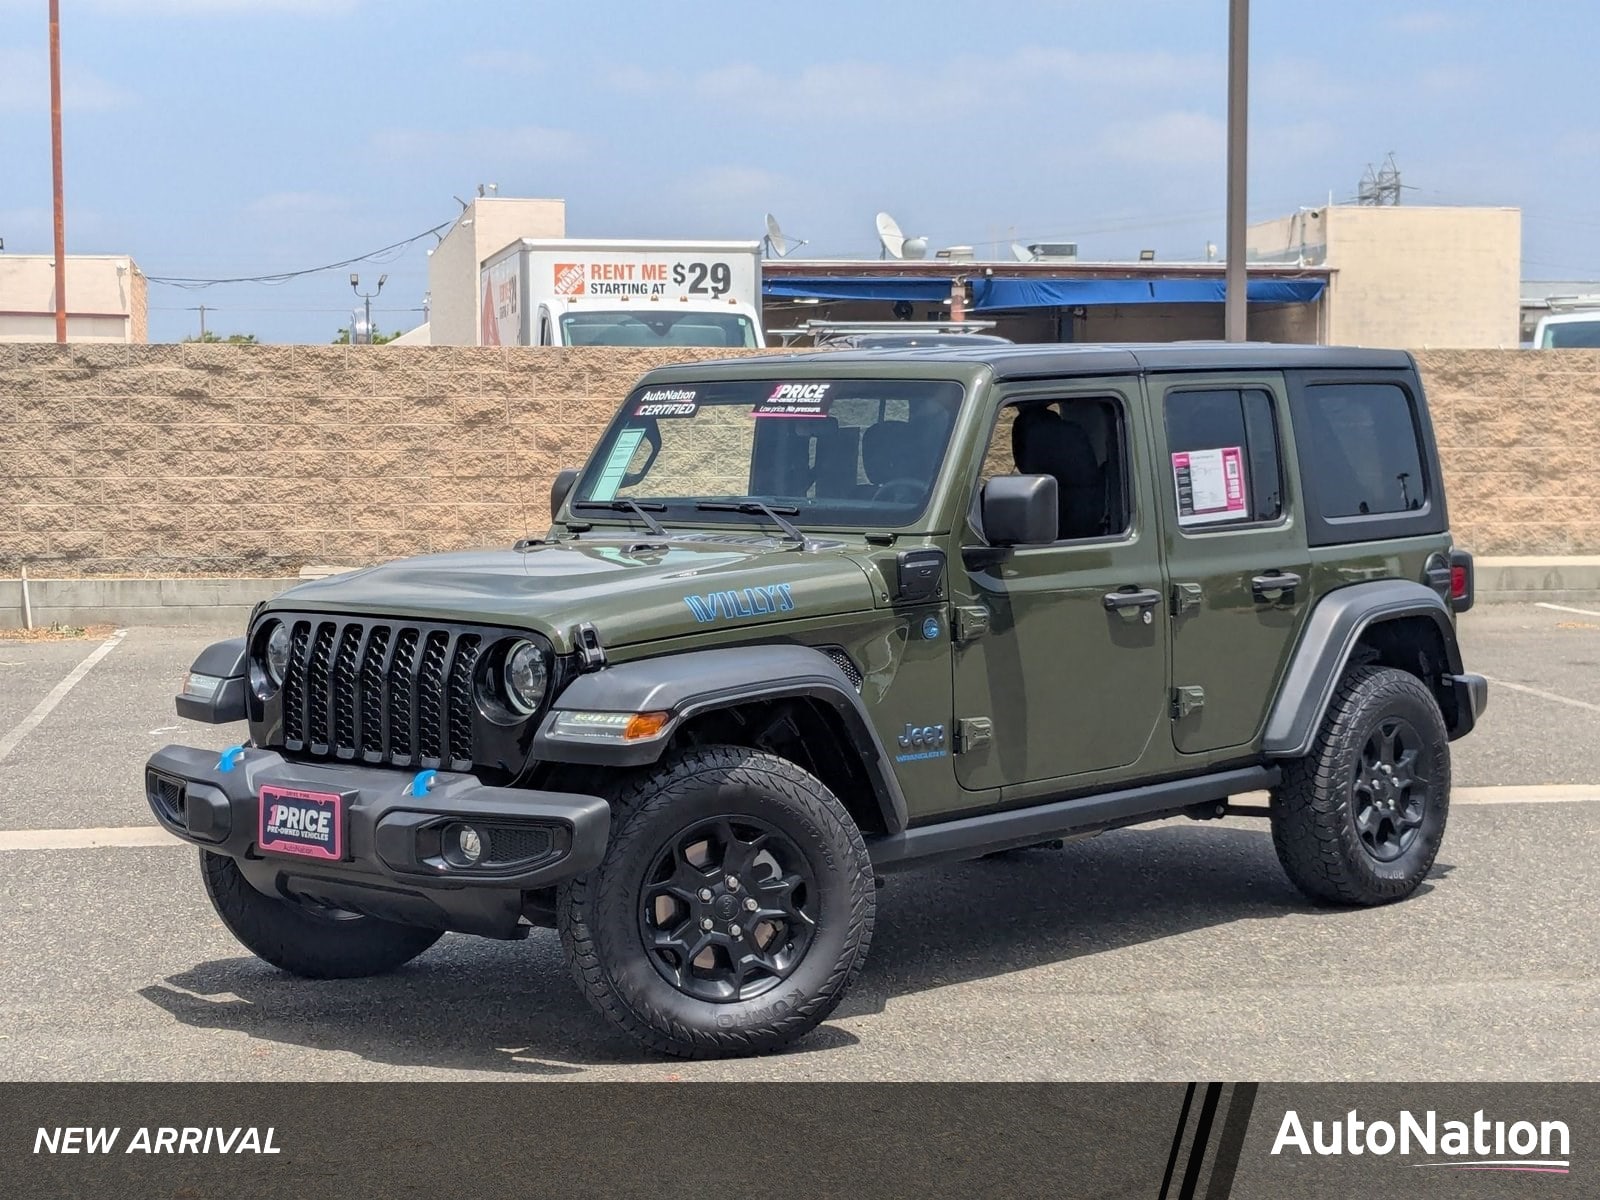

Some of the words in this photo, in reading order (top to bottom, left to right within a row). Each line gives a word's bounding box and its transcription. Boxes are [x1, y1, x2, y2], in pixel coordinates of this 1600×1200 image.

[590, 283, 648, 295] STARTING
[651, 283, 667, 295] AT
[591, 264, 635, 280] RENT
[641, 264, 667, 280] ME
[673, 262, 732, 295] $29
[641, 389, 696, 402] AutoNation
[639, 403, 696, 416] CERTIFIED
[684, 583, 794, 622] WILLYS
[897, 722, 945, 748] Jeep
[268, 804, 331, 834] 1PRICE
[267, 825, 300, 837] PRE-OWNED
[300, 831, 328, 841] VEHICLES
[716, 988, 805, 1029] KUMHO
